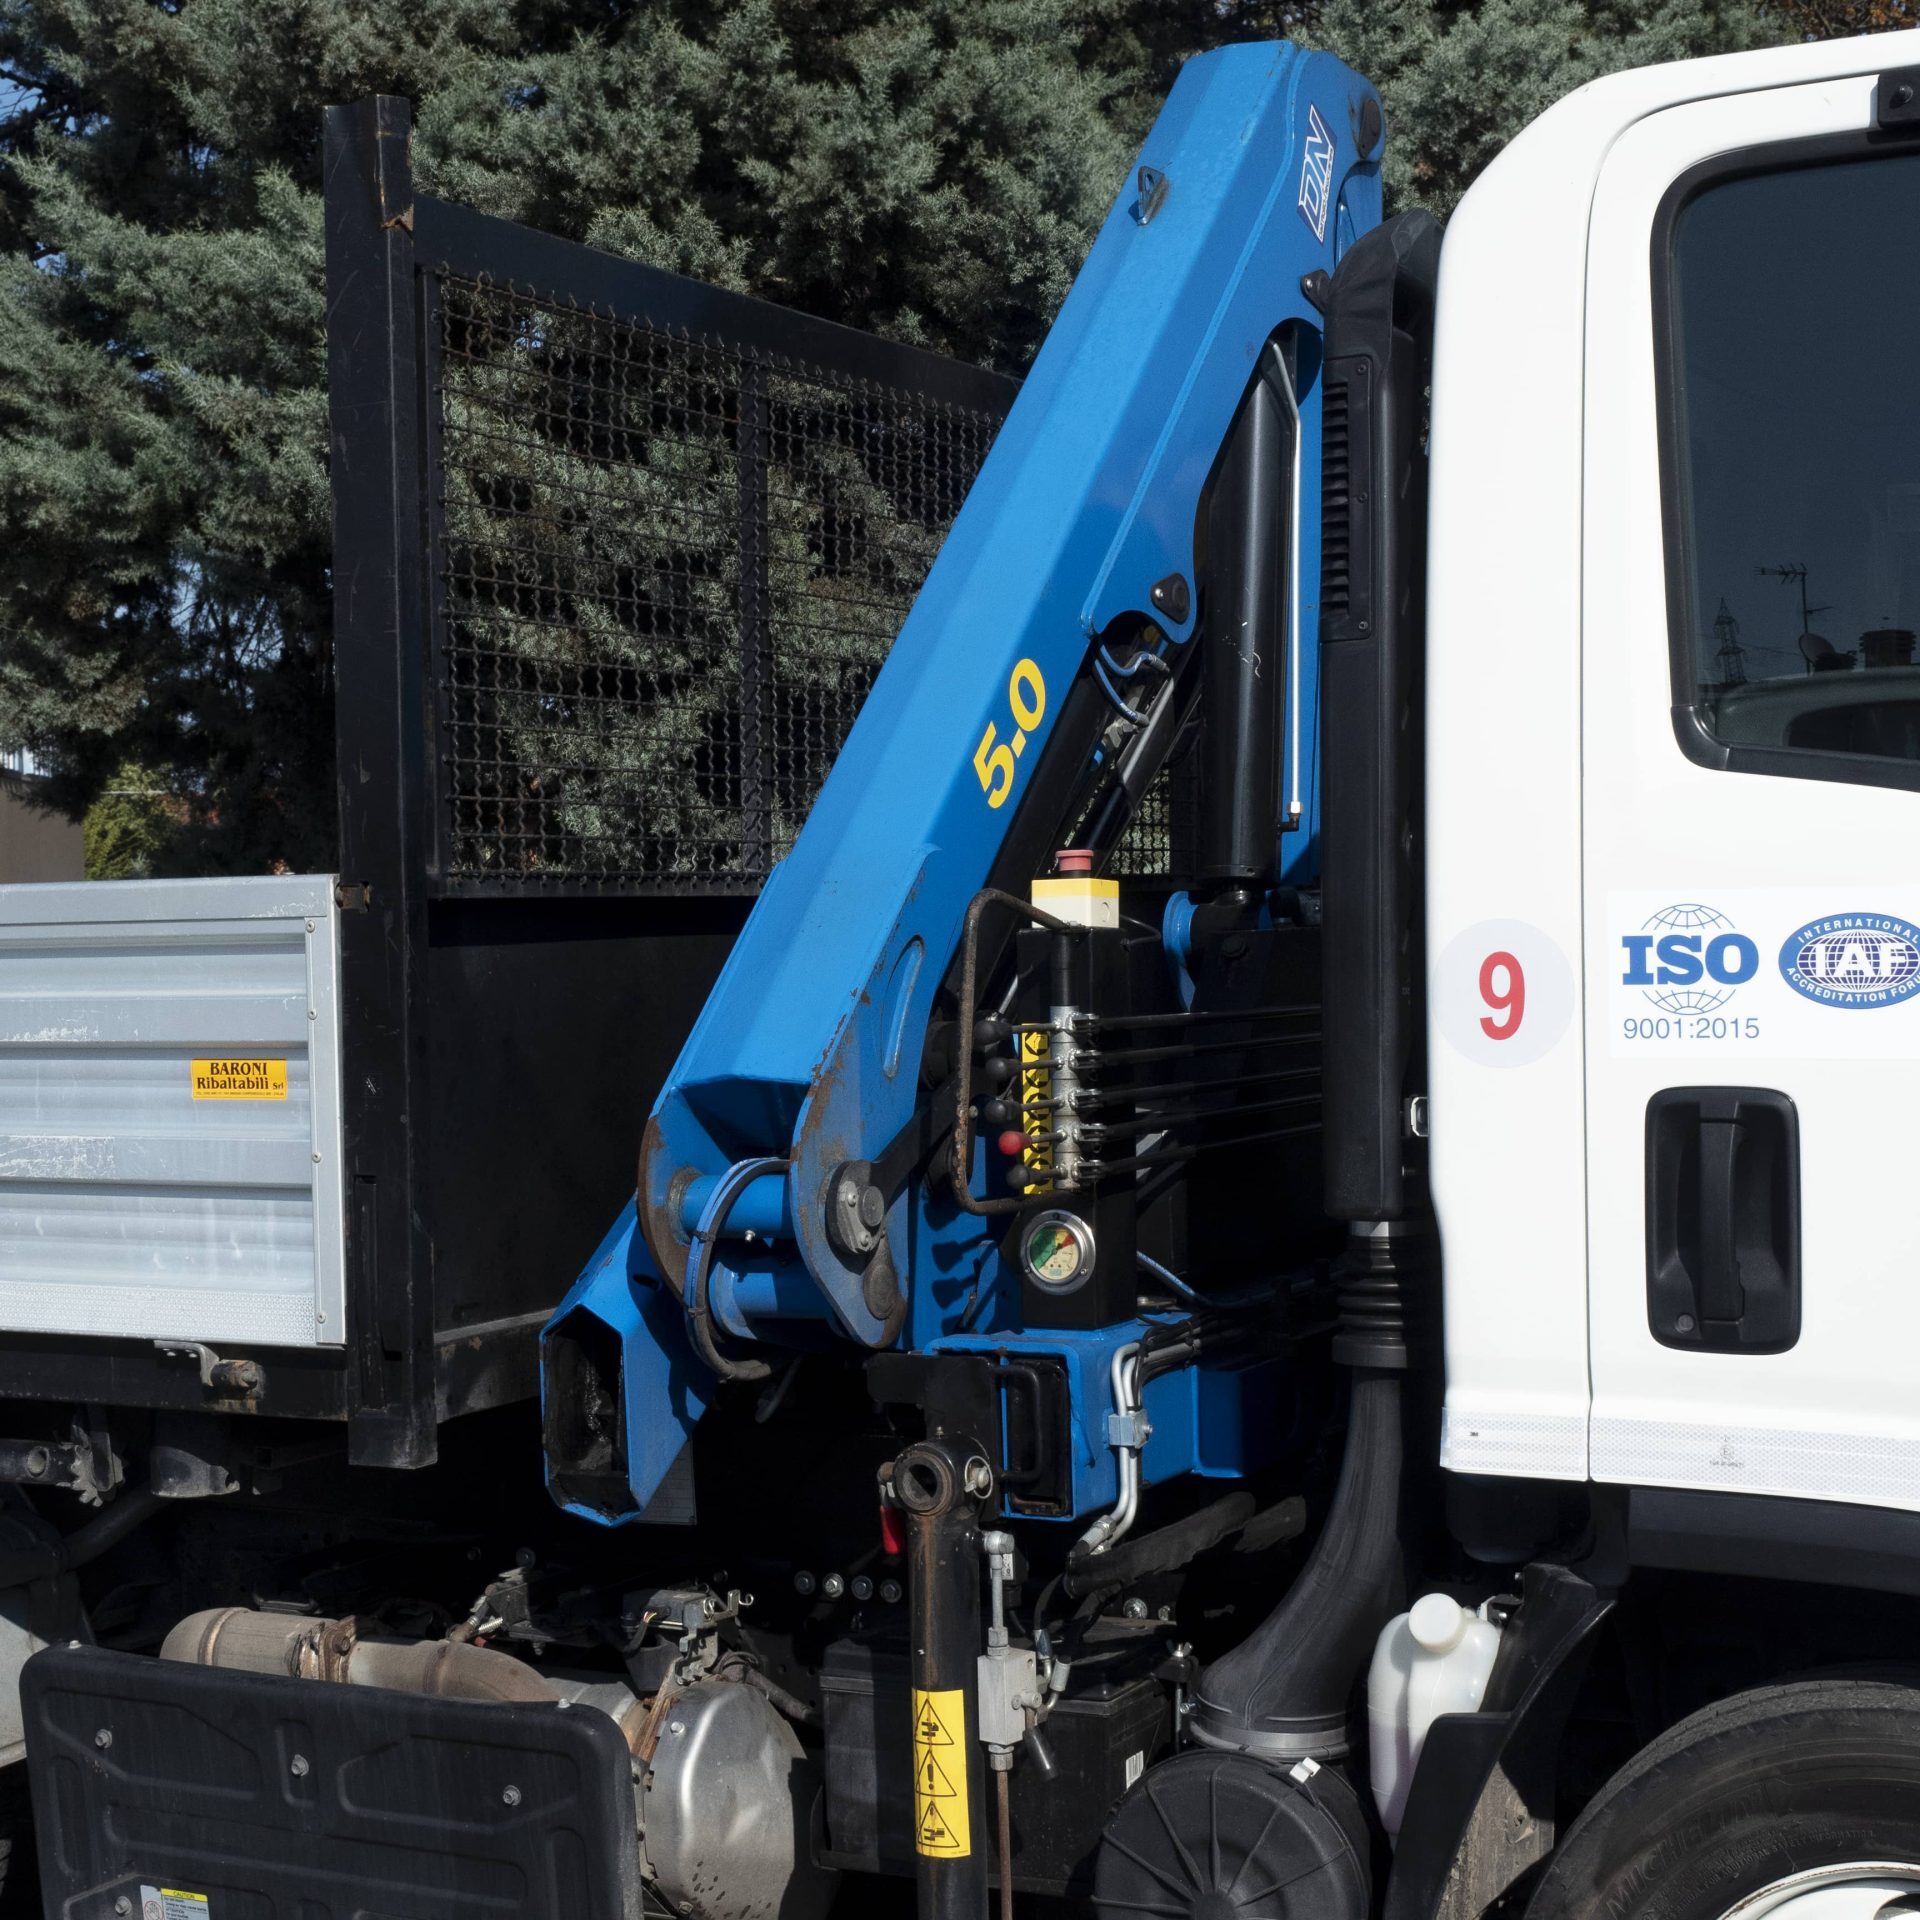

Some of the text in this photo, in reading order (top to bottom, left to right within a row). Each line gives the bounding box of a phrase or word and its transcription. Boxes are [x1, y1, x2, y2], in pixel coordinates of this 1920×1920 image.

[973, 658, 1046, 809] 5.0
[1798, 918, 1920, 944] INTERNATIONAL
[1622, 933, 1760, 986] ISO
[1816, 943, 1906, 978] IAF
[1479, 951, 1526, 1041] 9
[1786, 966, 1920, 1003] ACCREDITATION FORU
[1623, 1018, 1760, 1040] 9001:2015
[197, 1077, 284, 1090] Ribaltabili Srl
[210, 1062, 267, 1076] BARONI
